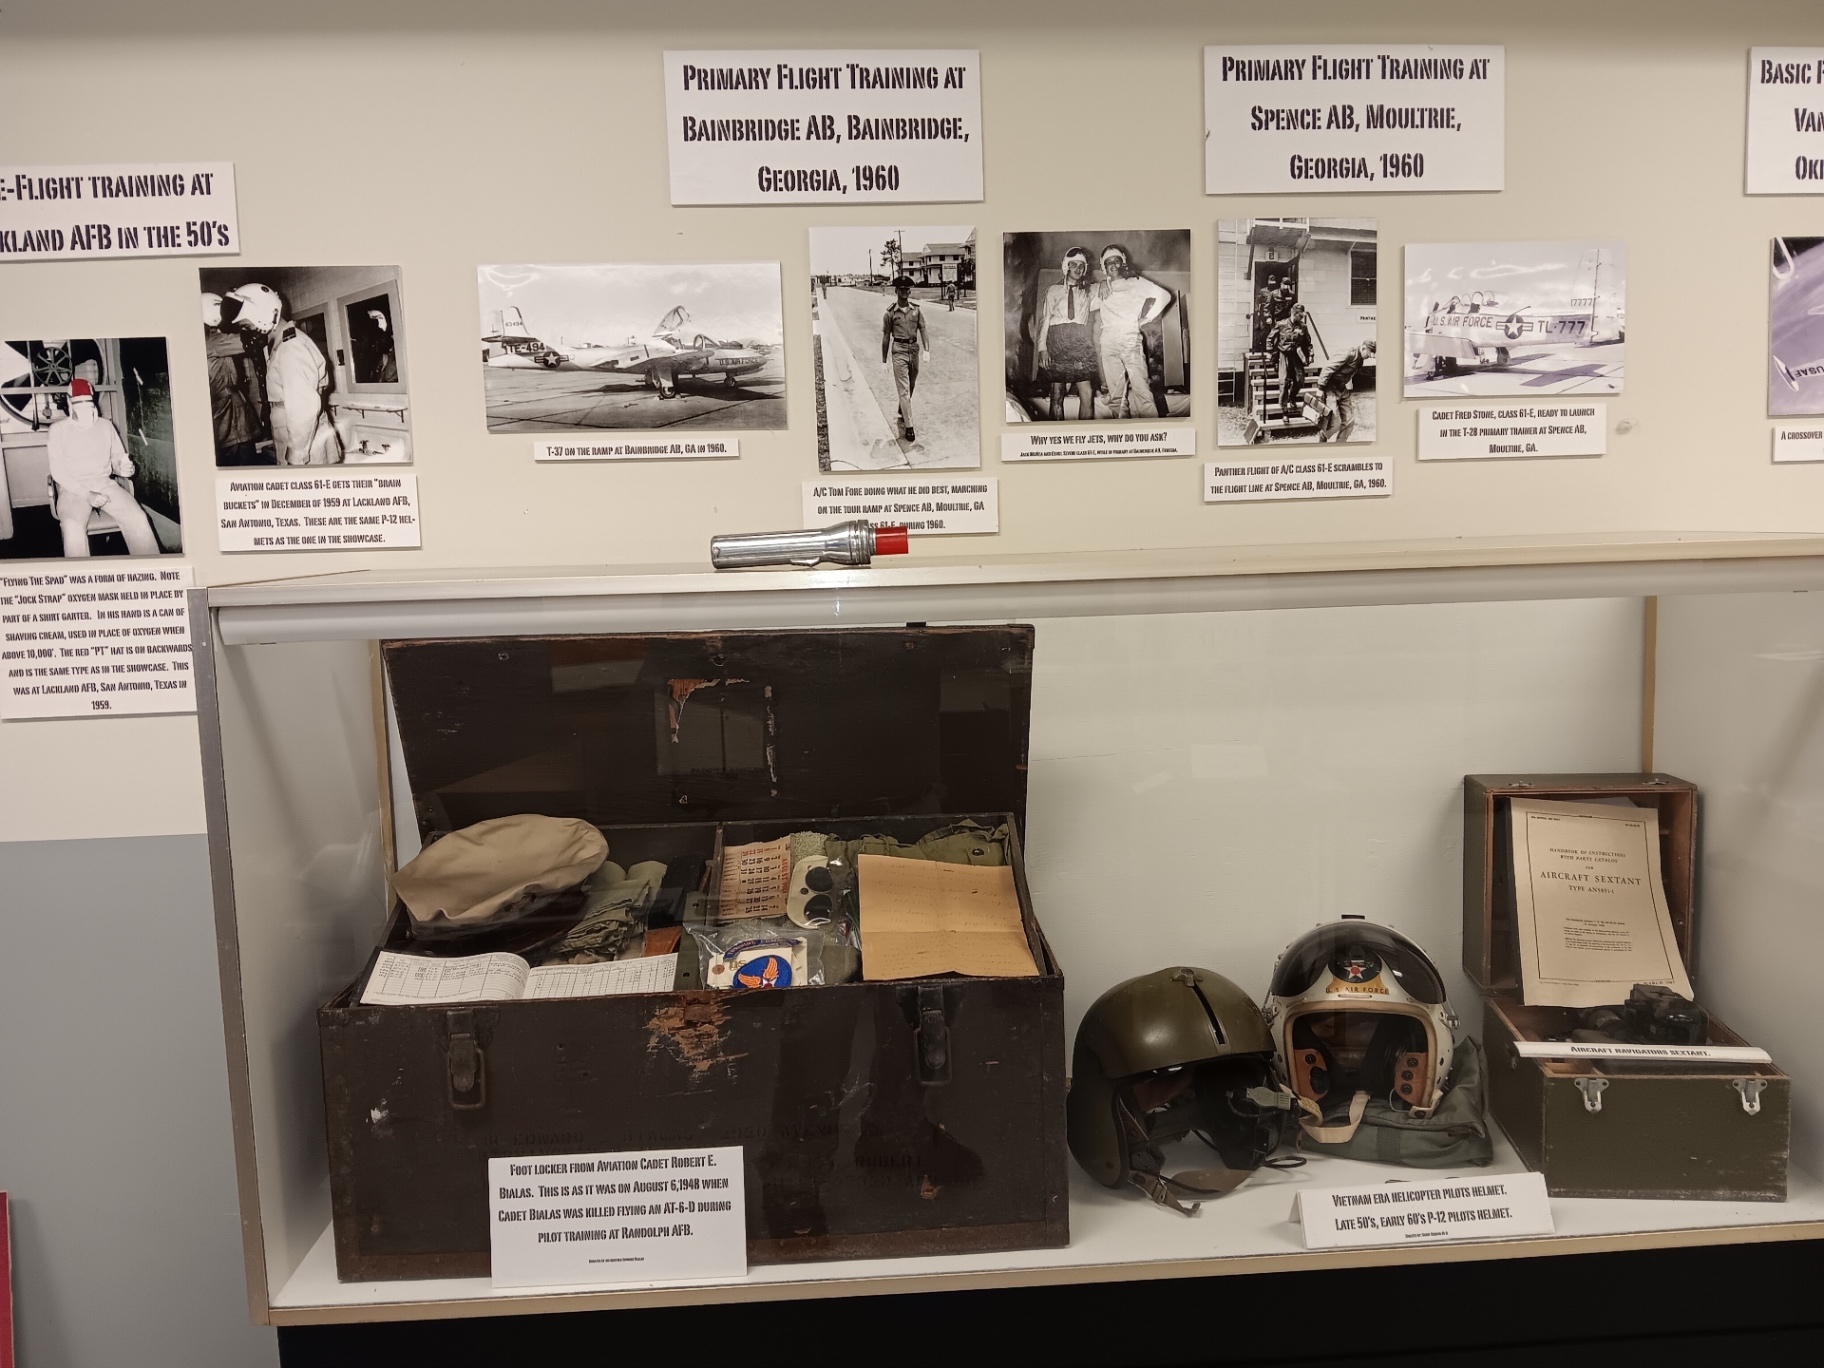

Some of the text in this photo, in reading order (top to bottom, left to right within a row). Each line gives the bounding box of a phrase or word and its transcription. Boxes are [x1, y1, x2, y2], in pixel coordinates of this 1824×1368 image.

[683, 62, 965, 90] PRIMARY FLIGHT TRAINING AT
[1222, 54, 1489, 81] PRIMARY FLIGHT TRAINING AT
[1760, 59, 1812, 84] BASIC
[1250, 103, 1461, 135] SPENCE AB, MOULTRIE,
[682, 114, 969, 146] BAINBRIDGE AB, BAINBRIDGE,
[1289, 152, 1424, 182] GEORGIA, 1960
[88, 173, 185, 198] TRAINING
[190, 172, 213, 196] AT
[757, 164, 899, 194] GEORGIA, 1960
[0, 219, 229, 253] KLAND AFB IN THE 50'S
[1462, 316, 1492, 328] FORCE
[1432, 407, 1594, 420] CADET FRED STONE, CLASS 61-E, READY TO LAUNCH
[1030, 431, 1167, 445] WHY YES WE FLY JETS, WHY DO YOU ASK?
[1781, 431, 1823, 440] A CROSSOVER
[547, 442, 726, 456] T-37 ON THE RAMP AT BAINBRIDGE AB, GA IN 1960.
[230, 477, 401, 491] AVIATION CADET CLASS 61-E GETS THEIR "BRAIN
[813, 484, 987, 498] A/C TOM FORE DOING WHAT HE DID BEST, MARCHING
[1210, 478, 1386, 494] THE FLIGHT LINE AT SPENCE AB, MOULTRIE, GA, 1960.
[223, 495, 410, 510] BUCKETS" IN DECEMBER OF 1959 AT LACKLAND AFB,
[87, 574, 93, 584] A
[1540, 871, 1641, 886] AIRCRAFT SEXTANT
[1363, 987, 1389, 995] FORCE
[1570, 1046, 1612, 1054] AIRCRAFT
[510, 1153, 716, 1176] FOOT LOCKER FROM AVIATION CADET ROBERT E.
[1331, 1184, 1506, 1207] VIETNAM ERA HELICOPTER PILOTS HELMET.
[498, 1200, 731, 1222] CADET BIALAS WAS KILLED FLYING AN AT-6-D DURING
[1334, 1206, 1512, 1231] LATE 50'S, EARLY 60'S P-12 PILOTS HELMET.
[538, 1223, 693, 1243] PILOT TRAINING AT RANDOLPH AFB.
